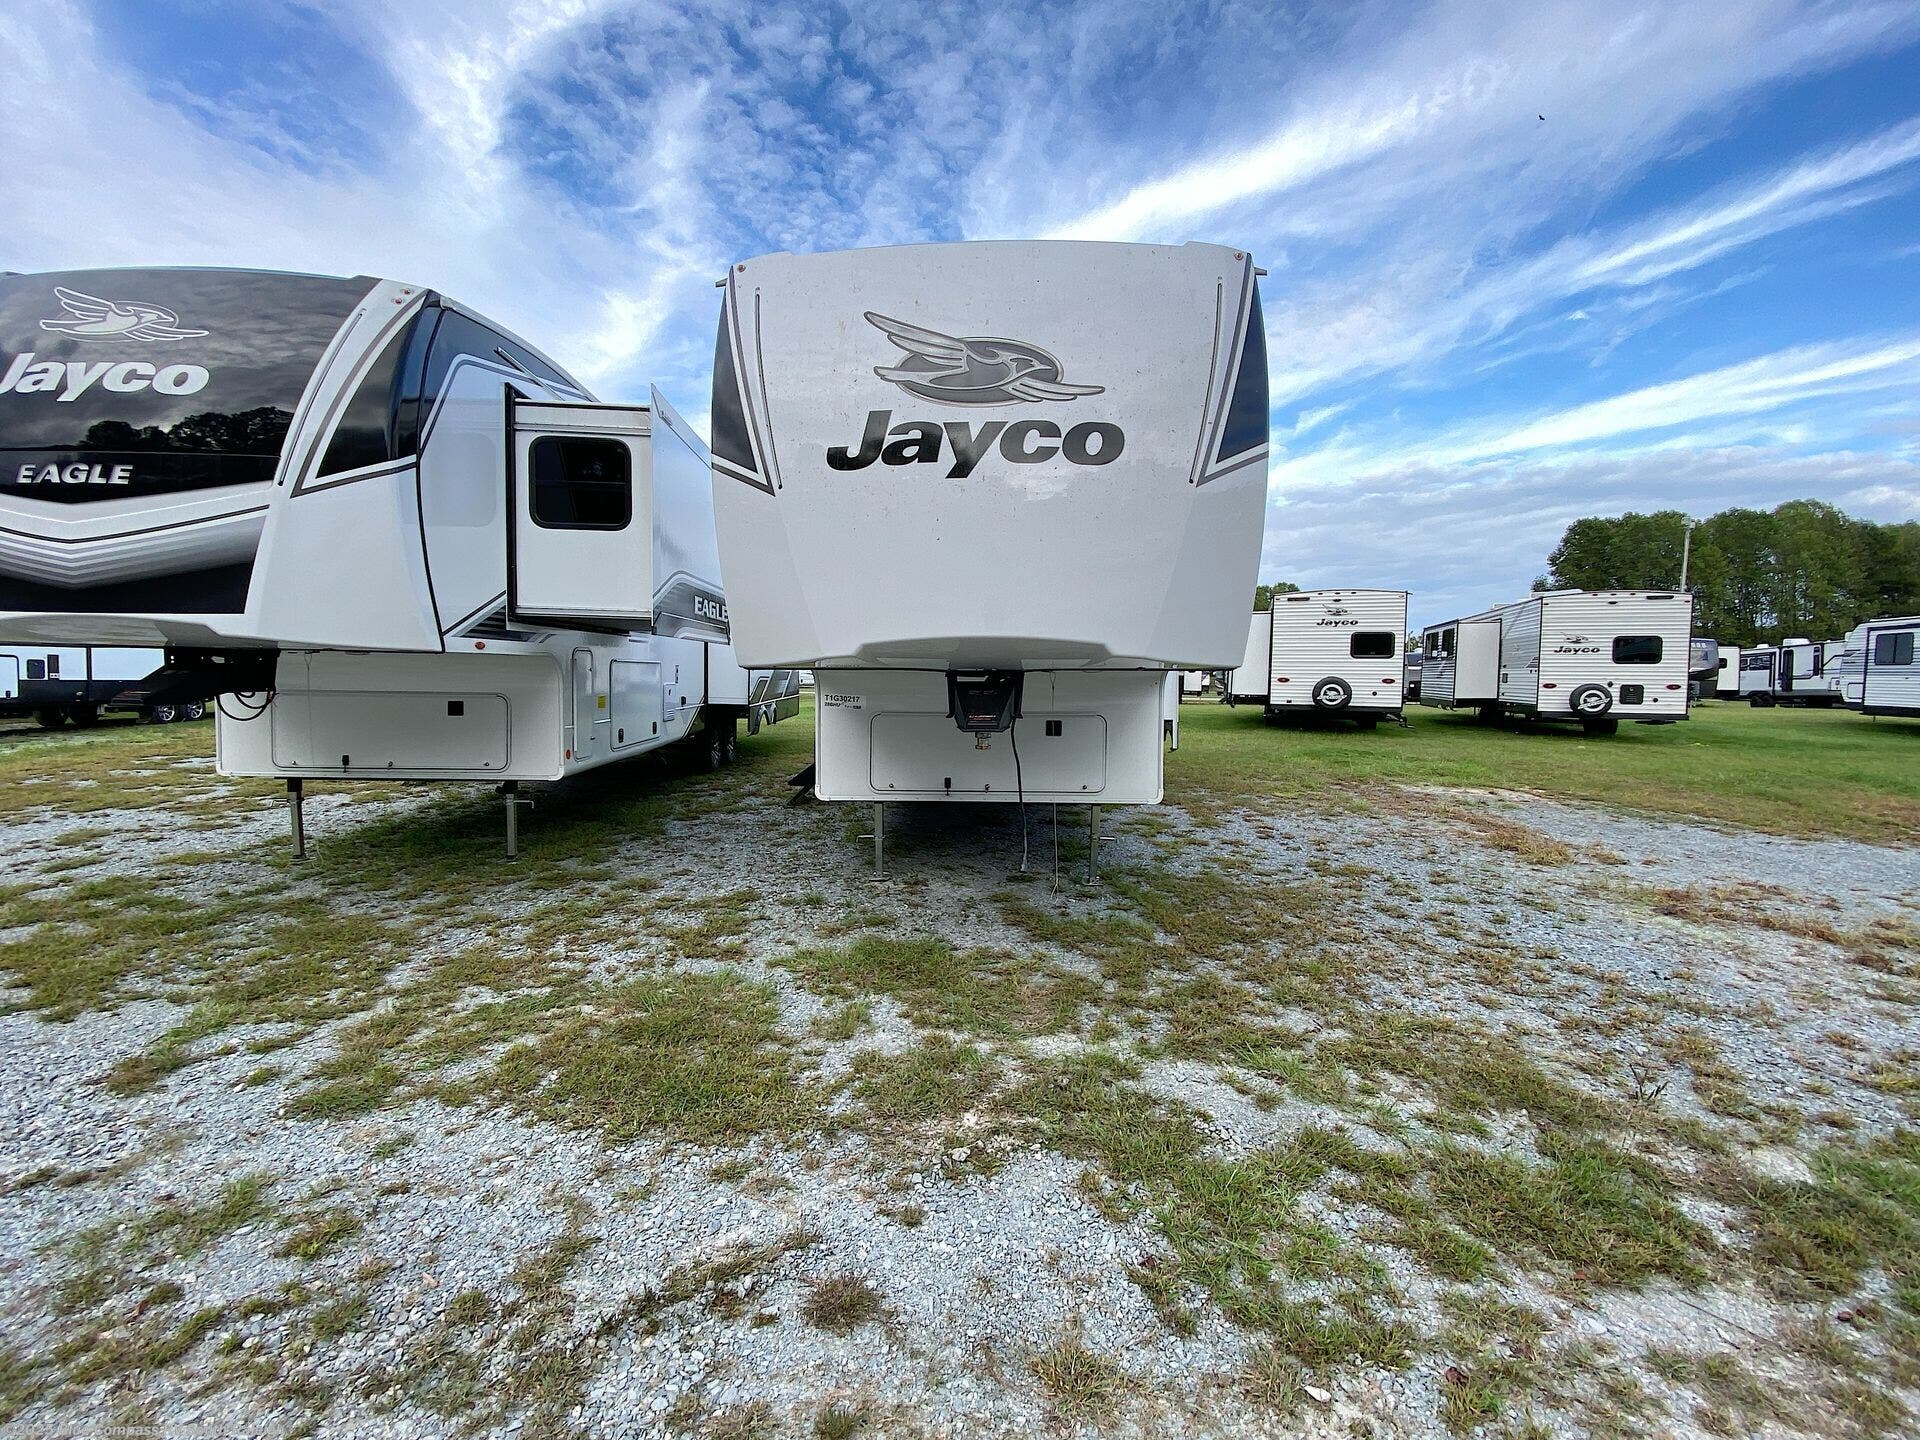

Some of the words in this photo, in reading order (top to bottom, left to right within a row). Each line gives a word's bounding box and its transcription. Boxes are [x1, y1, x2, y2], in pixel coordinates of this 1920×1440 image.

[0, 352, 210, 402] Jayco
[826, 409, 1126, 479] Jayco
[15, 462, 134, 485] EAGLE
[694, 595, 729, 623] EAGLE
[1316, 618, 1359, 628] Jayco
[1553, 646, 1601, 655] Jayco
[824, 693, 861, 704] T1G30217
